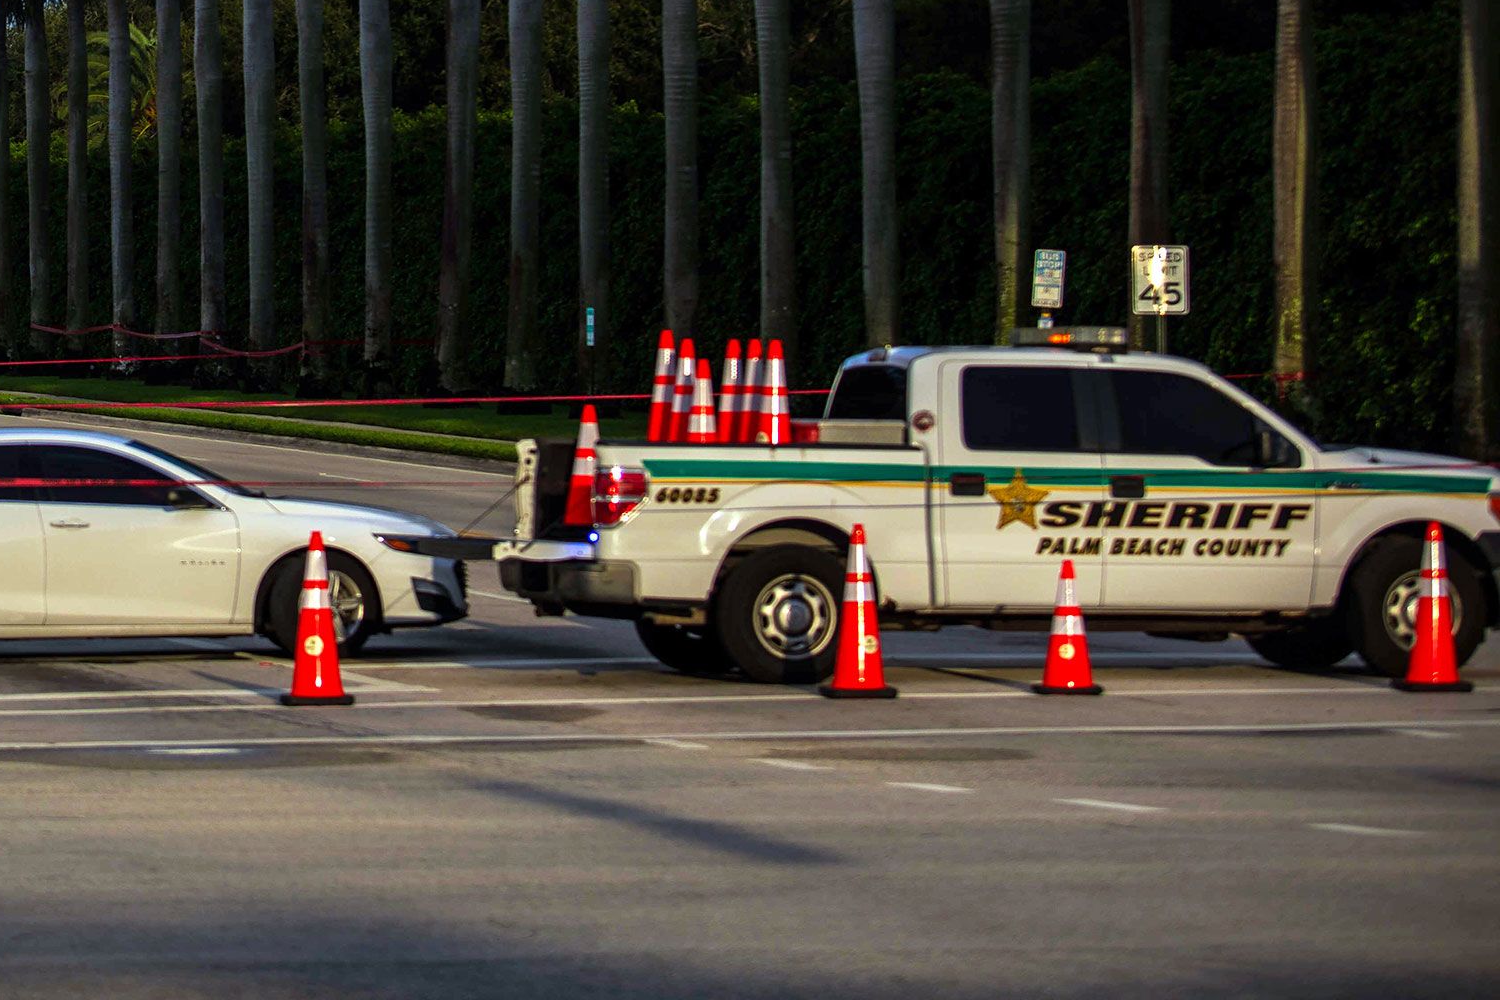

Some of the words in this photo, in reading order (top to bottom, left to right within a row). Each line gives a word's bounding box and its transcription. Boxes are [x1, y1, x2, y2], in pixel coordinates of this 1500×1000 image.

[1138, 251, 1182, 263] SPED
[1138, 281, 1182, 306] 45
[655, 486, 721, 503] 60085
[1039, 501, 1312, 530] SHERIFF
[1035, 536, 1103, 556] PALM
[1108, 537, 1187, 556] BEACH
[1192, 538, 1292, 557] COUNTY
